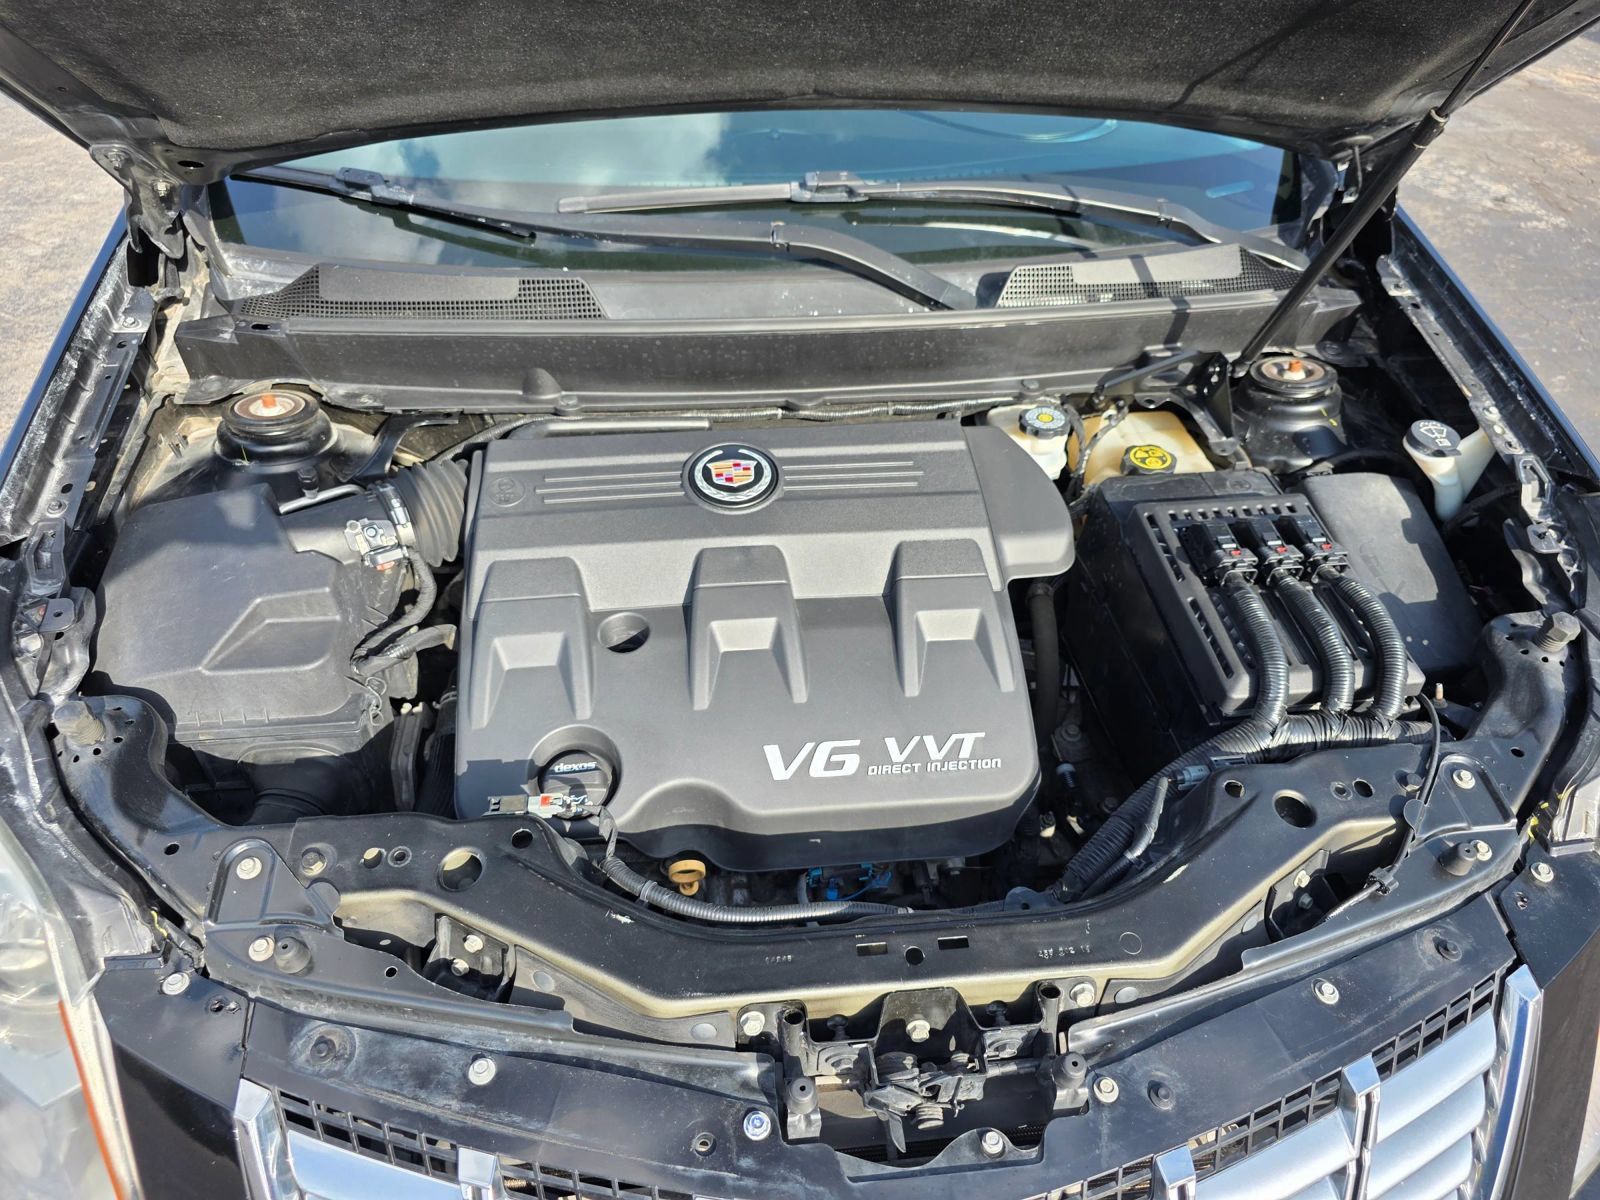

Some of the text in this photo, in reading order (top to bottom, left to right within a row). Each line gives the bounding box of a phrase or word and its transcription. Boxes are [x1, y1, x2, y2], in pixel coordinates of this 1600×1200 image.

[763, 731, 986, 781] V6 VVT
[554, 761, 598, 773] dexos
[867, 758, 1002, 776] DIRECT INJECTION
